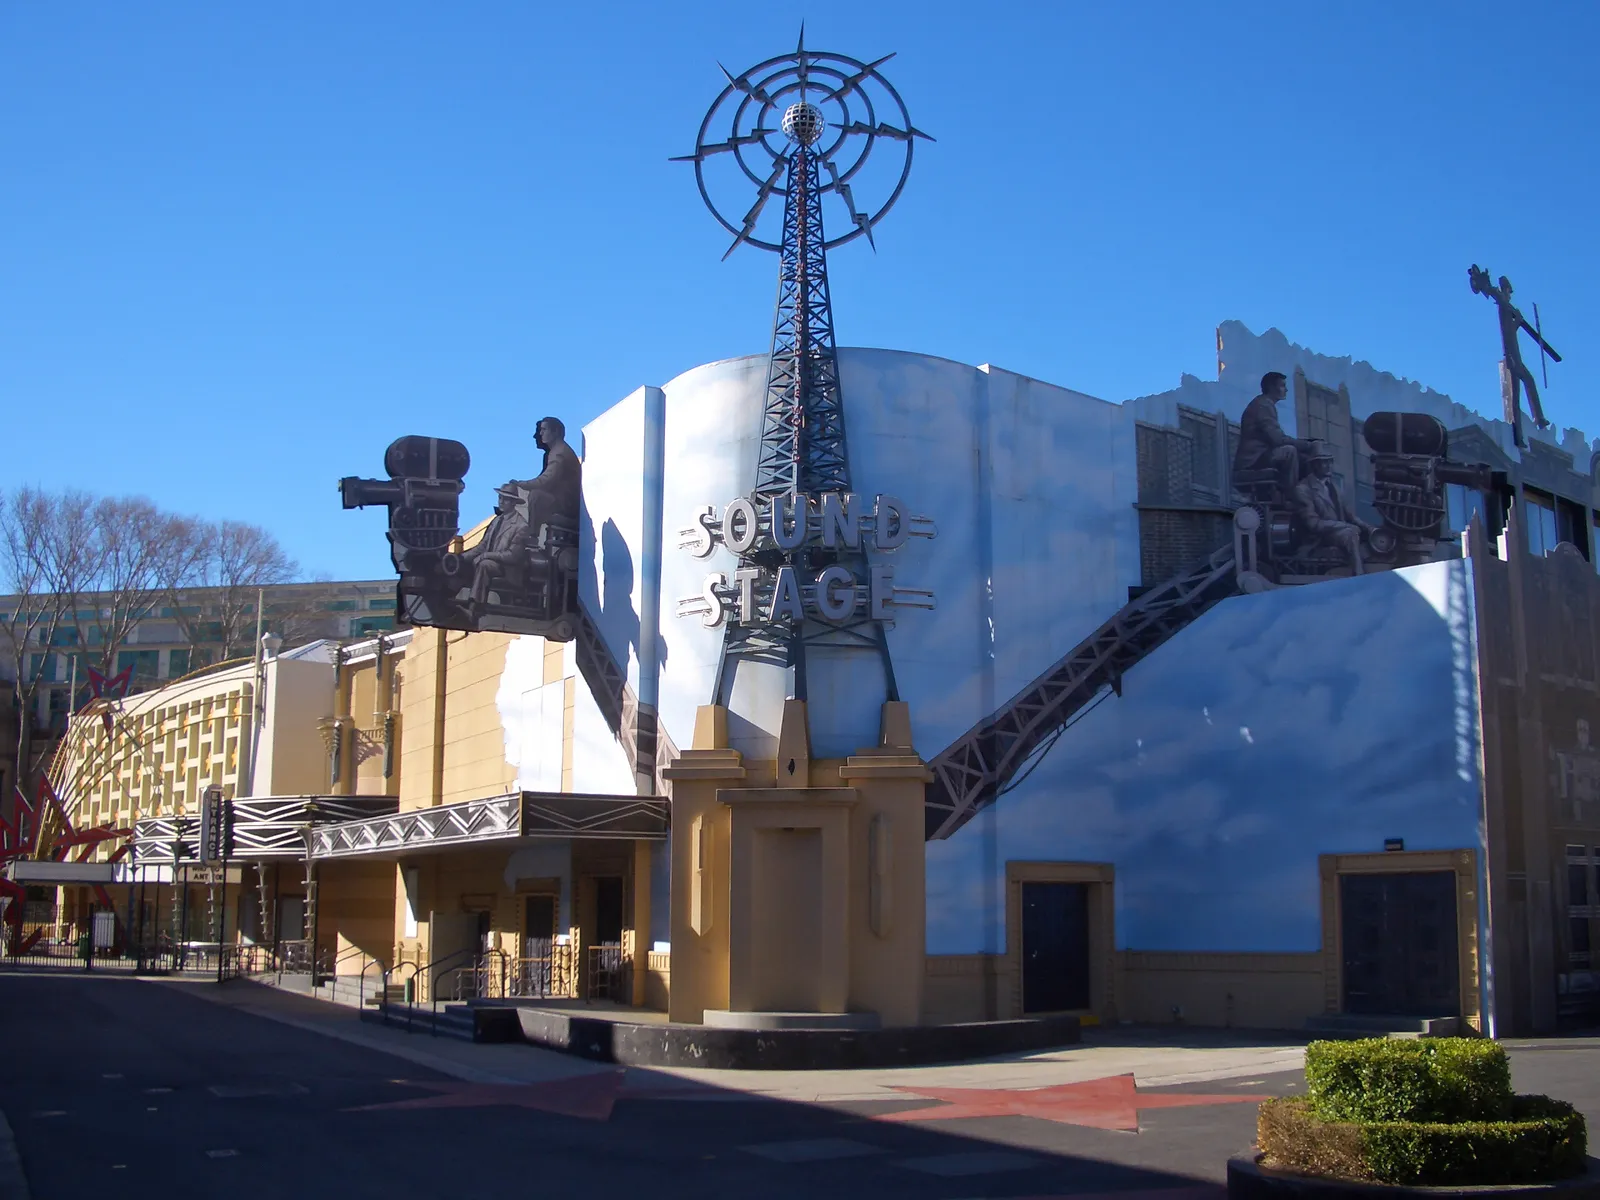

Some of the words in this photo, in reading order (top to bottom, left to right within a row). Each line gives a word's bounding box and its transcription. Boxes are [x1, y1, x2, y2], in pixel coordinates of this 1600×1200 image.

[691, 493, 909, 558] SOUND
[703, 565, 895, 627] STAGE
[208, 791, 219, 859] ENTRANCE
